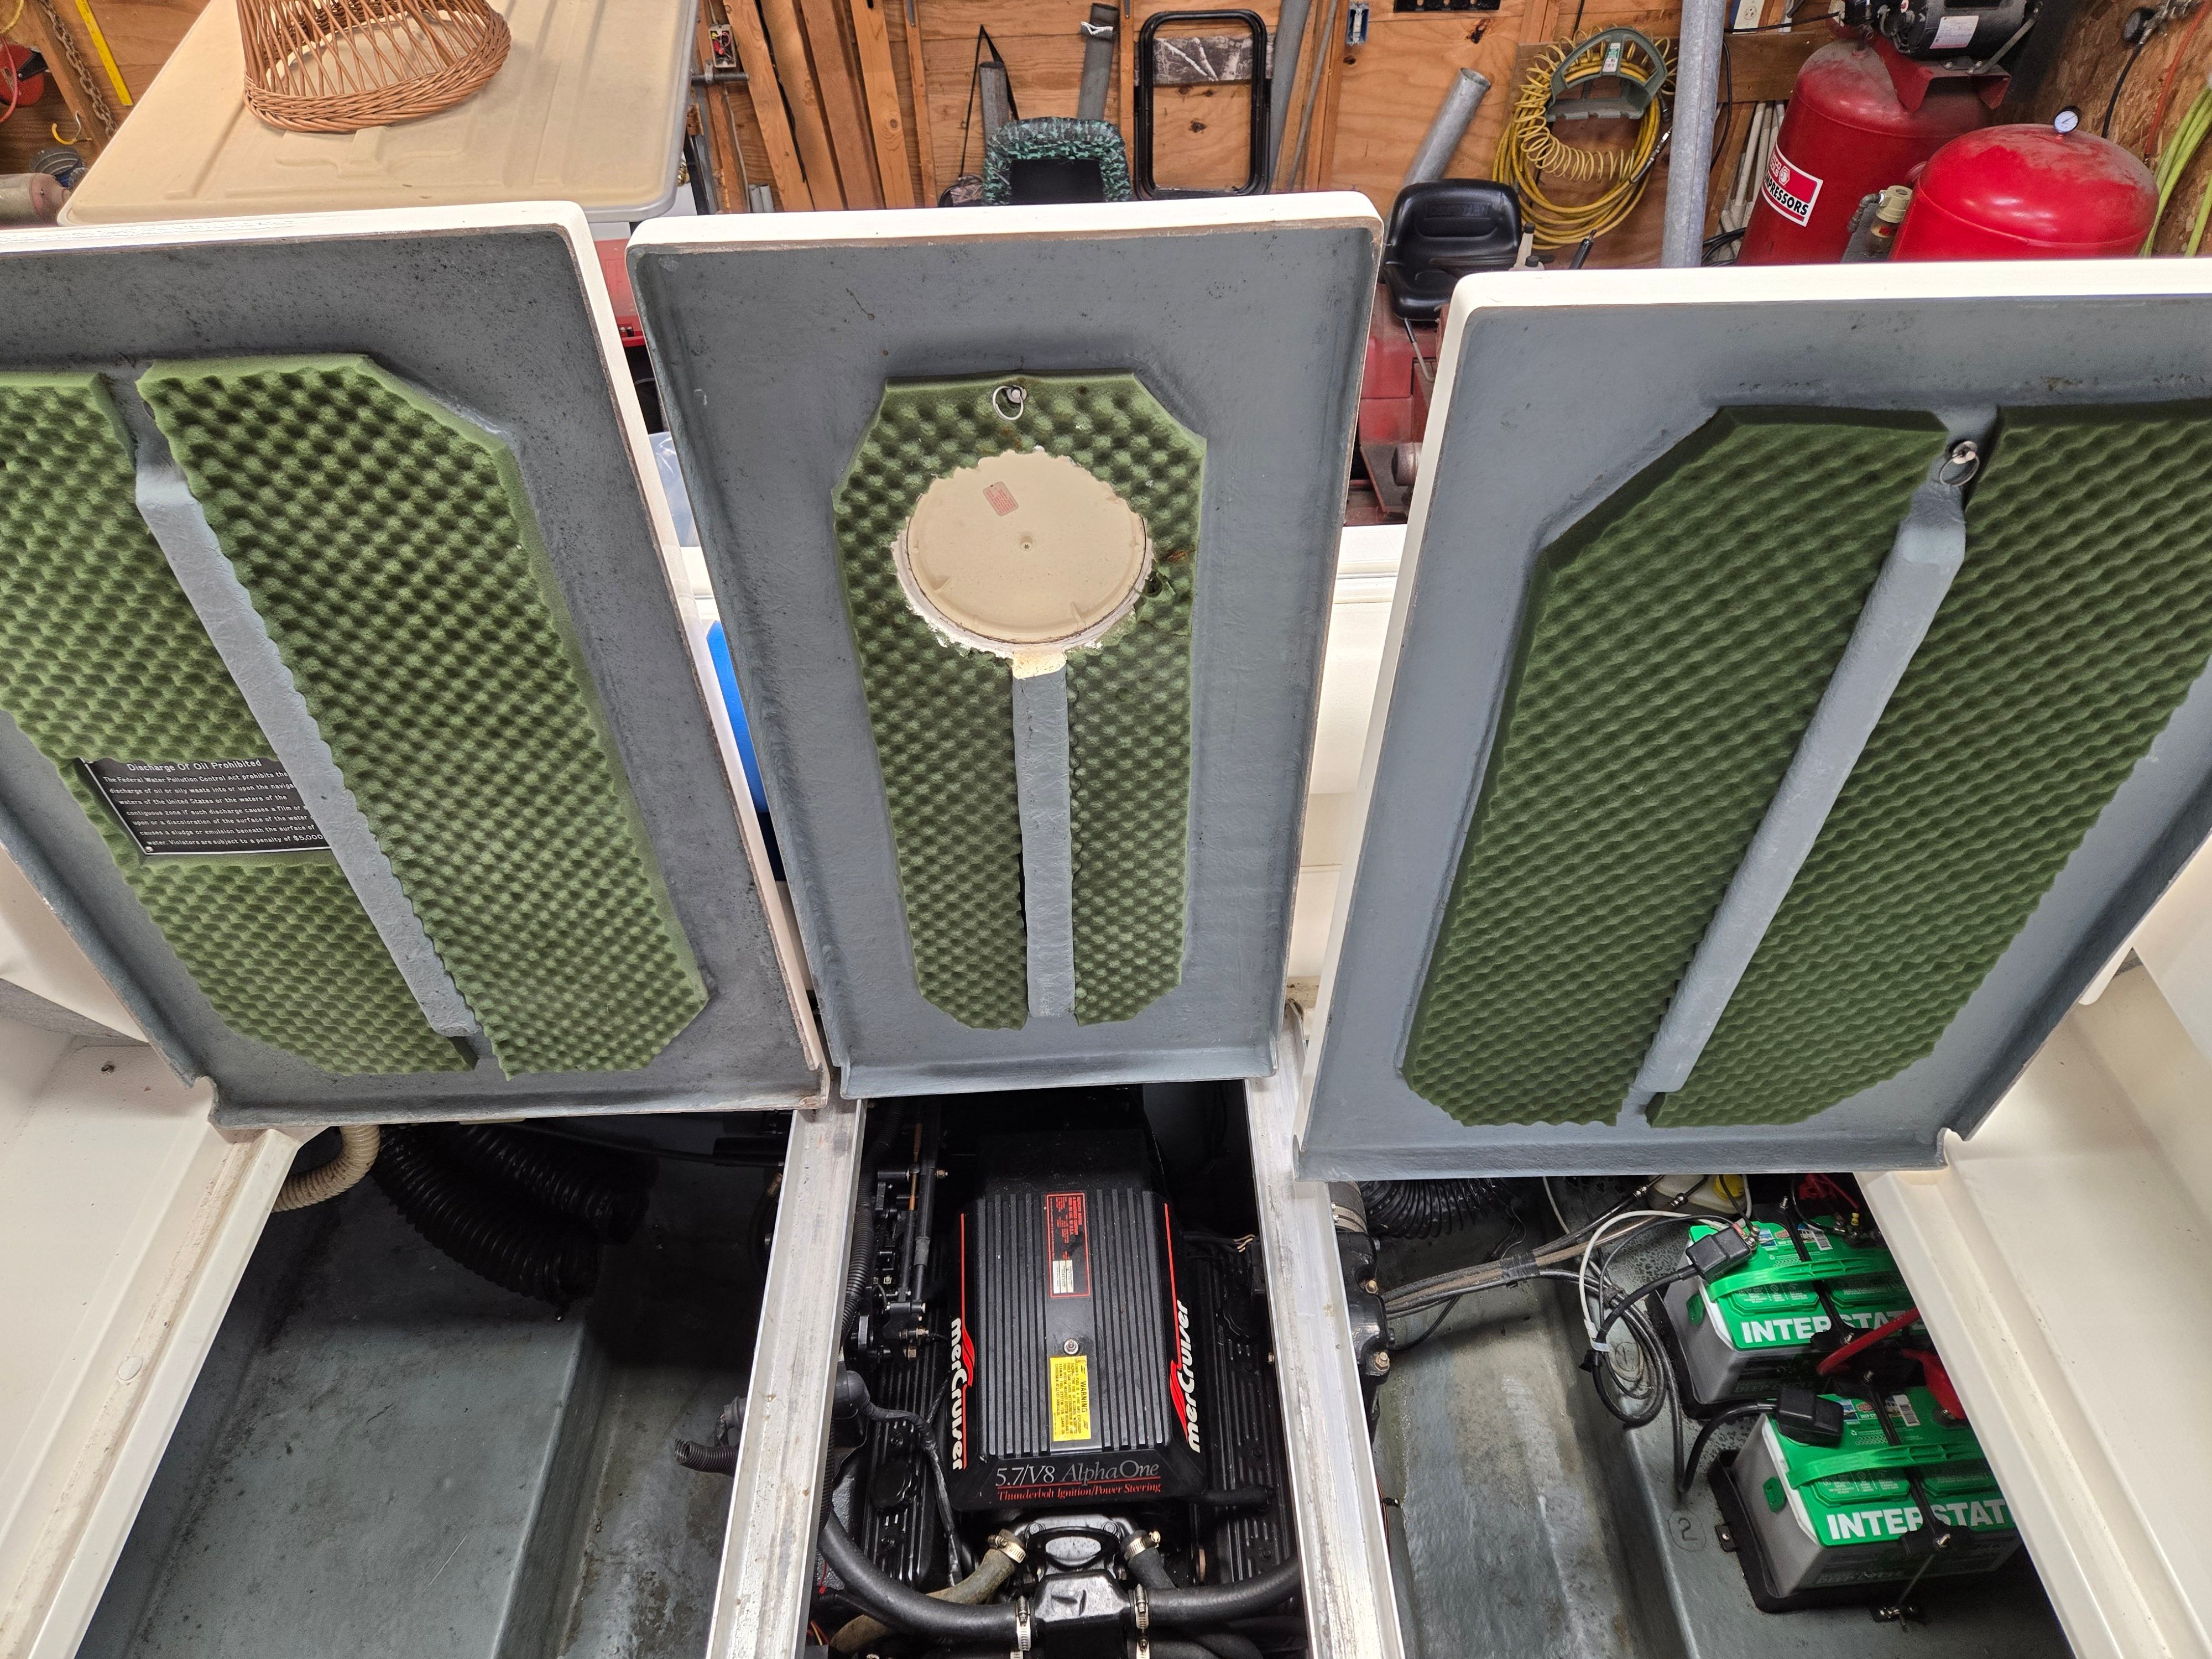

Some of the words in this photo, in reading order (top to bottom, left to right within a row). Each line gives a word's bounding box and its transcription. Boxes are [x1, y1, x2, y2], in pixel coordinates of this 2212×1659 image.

[127, 764, 175, 773] Discharge
[211, 759, 262, 769] Prohibited
[242, 772, 274, 781] prohibits
[995, 1464, 1055, 1486] 5.7/V8
[998, 1488, 1054, 1501] Thunderbolt
[1057, 1485, 1123, 1499] Ignition/Power
[1124, 1483, 1161, 1493] Steering
[1677, 1517, 1698, 1541] 2
